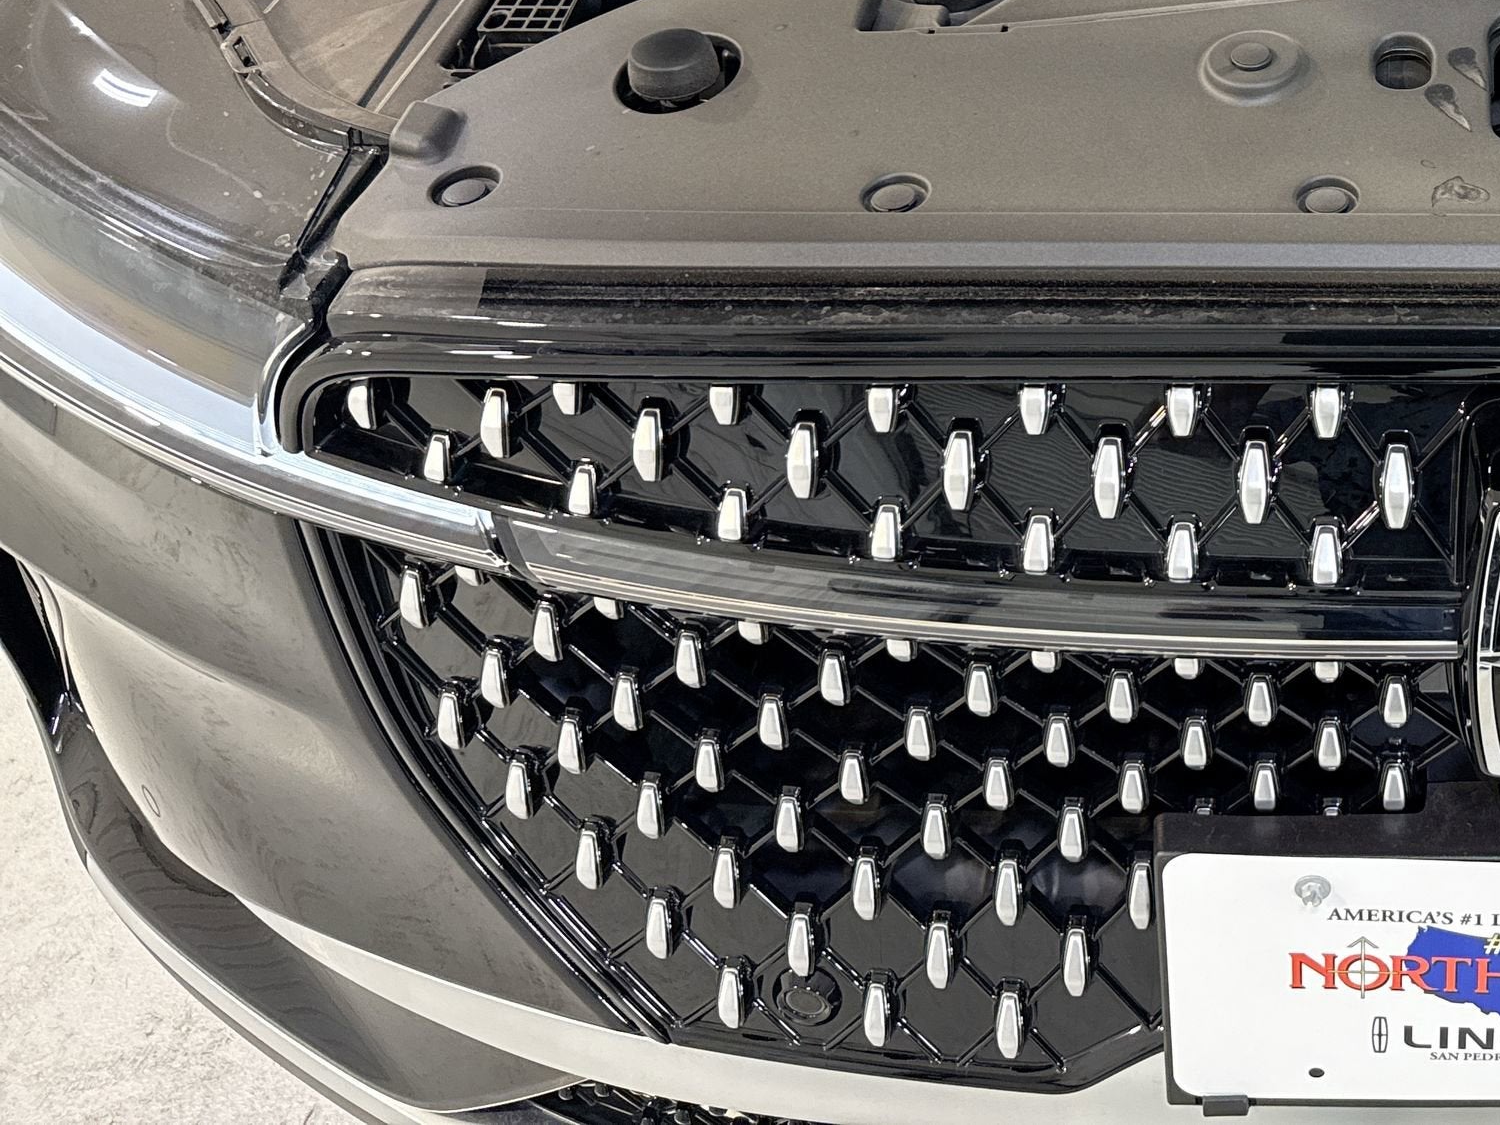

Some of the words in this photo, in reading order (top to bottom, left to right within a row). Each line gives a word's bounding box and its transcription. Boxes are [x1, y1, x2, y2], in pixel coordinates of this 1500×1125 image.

[1327, 907, 1454, 925] AMERICA'S
[1460, 913, 1483, 926] #1
[1429, 1051, 1459, 1061] SAN
